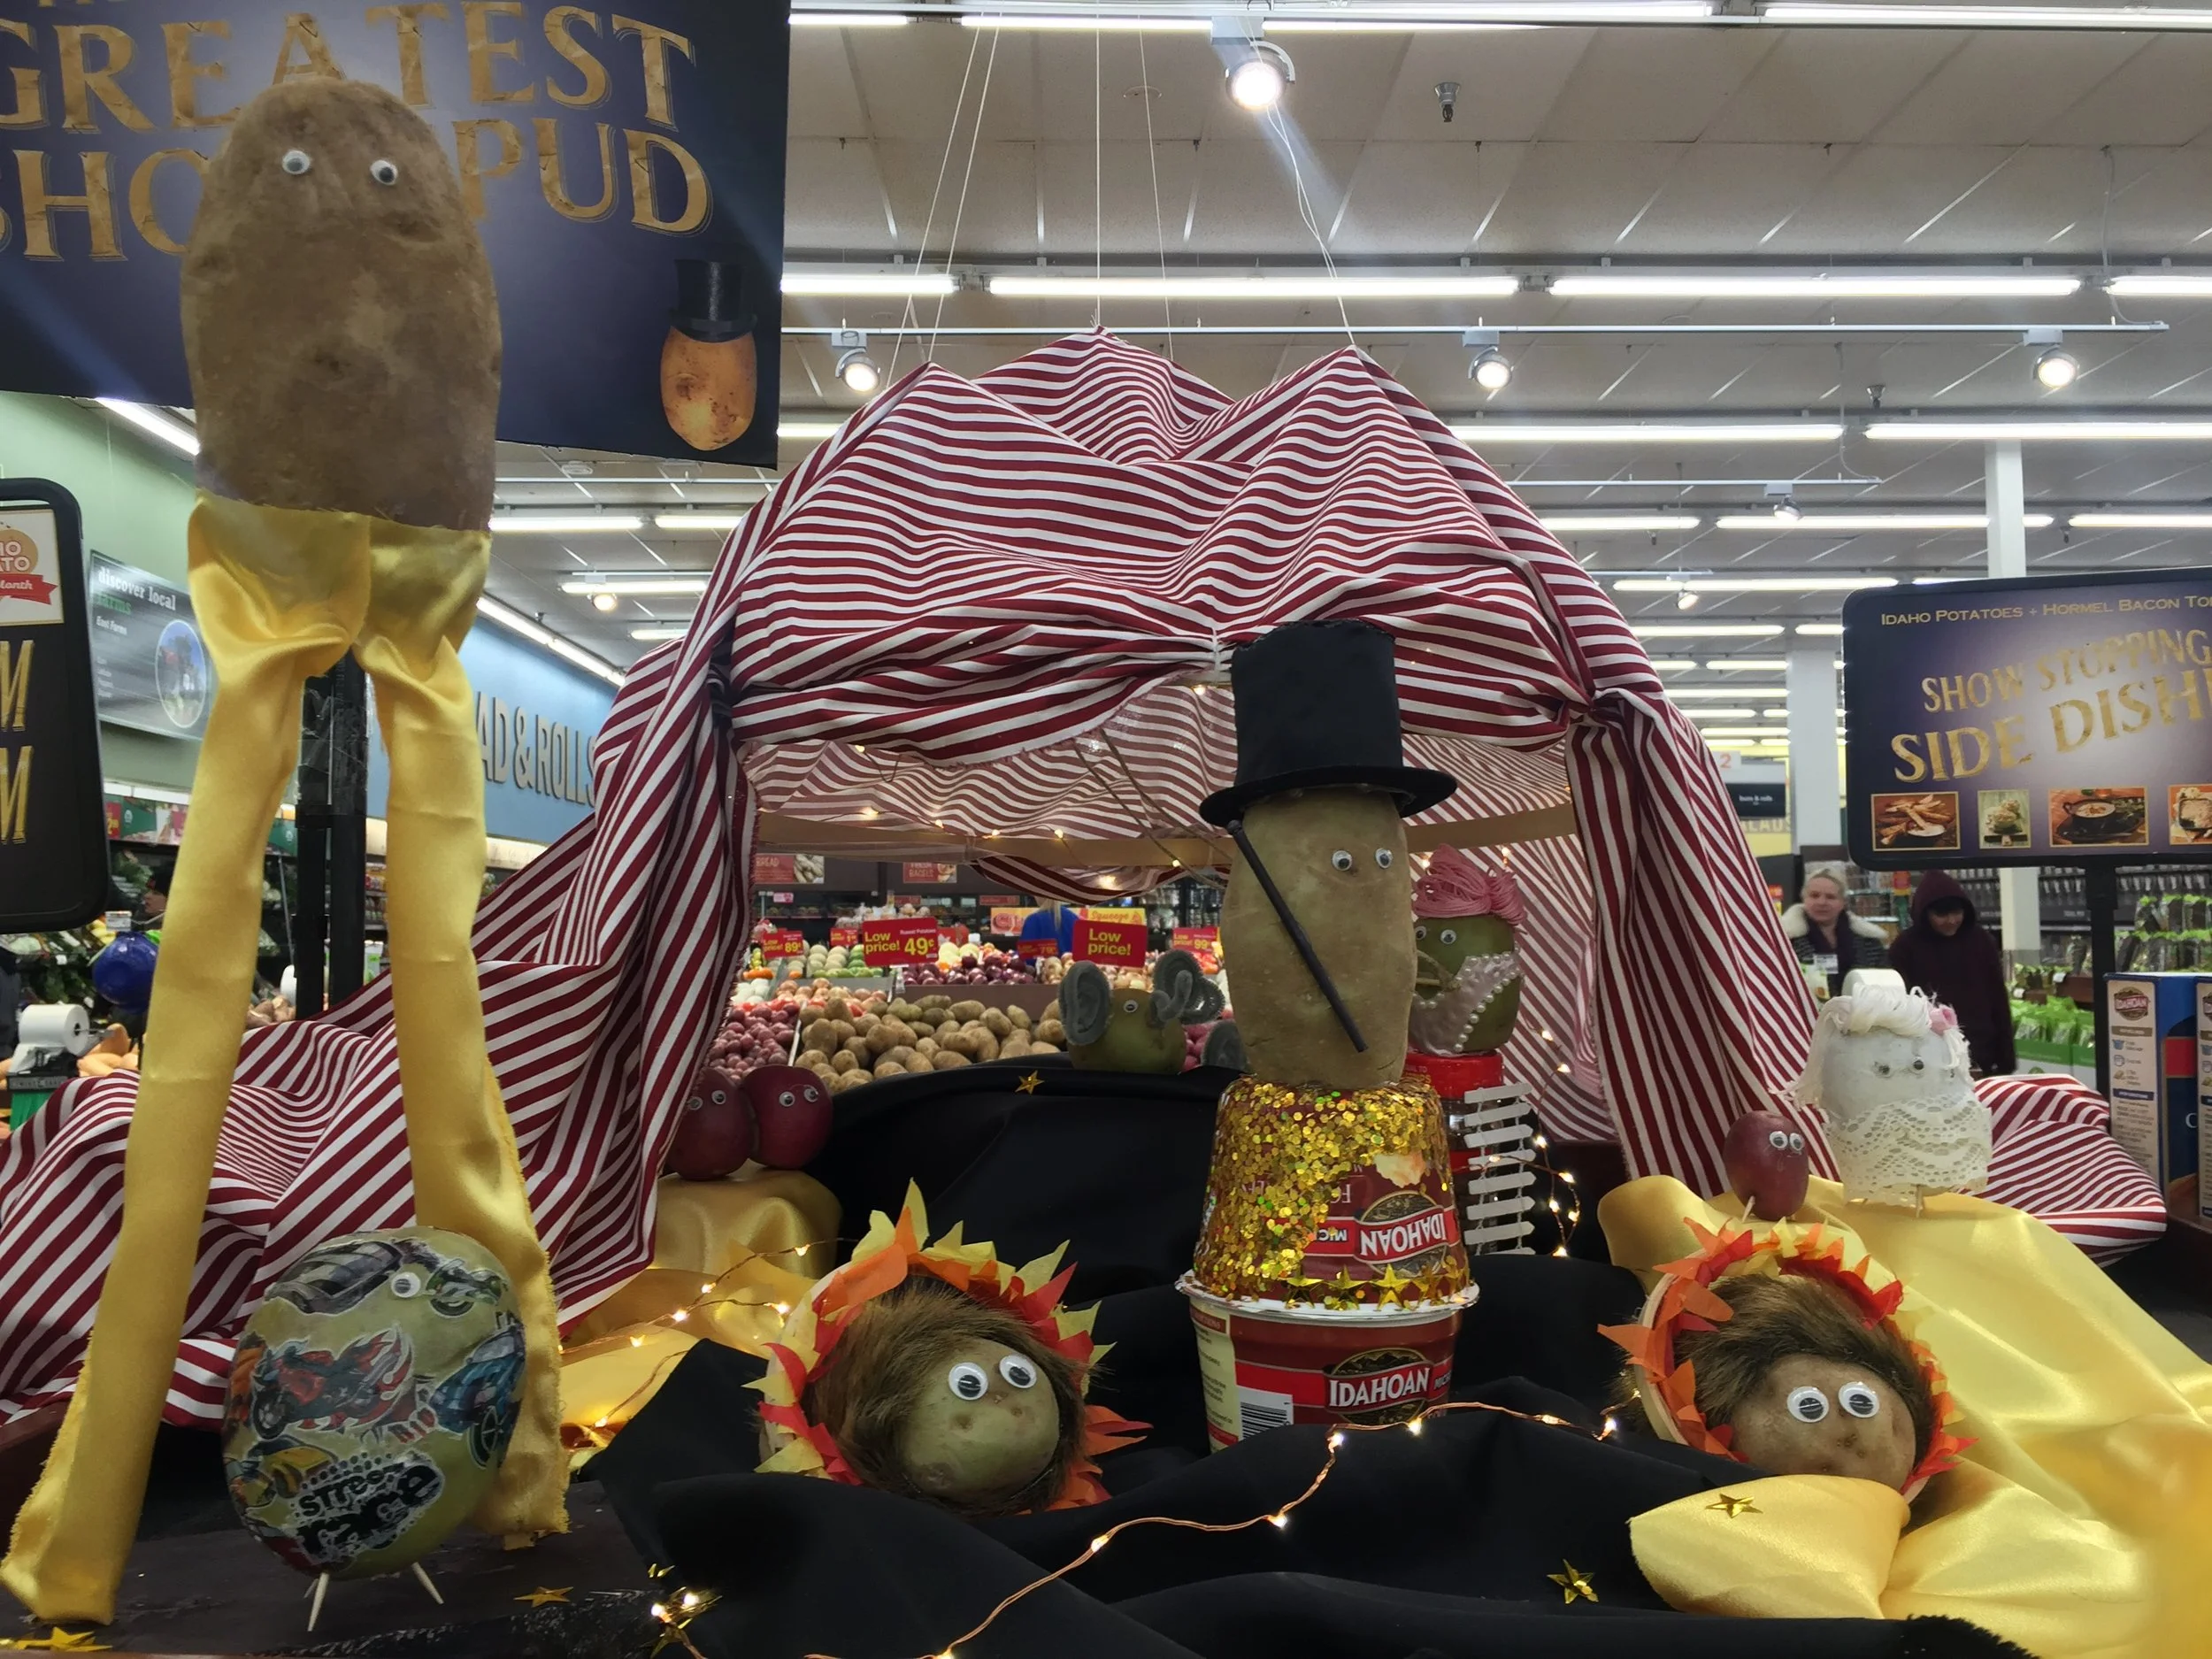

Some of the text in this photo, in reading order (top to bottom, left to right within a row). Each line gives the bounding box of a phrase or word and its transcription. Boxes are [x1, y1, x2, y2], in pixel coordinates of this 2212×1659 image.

[0, 117, 713, 260] HO PUD
[0, 580, 33, 590] onth
[98, 566, 176, 611] discover local
[1881, 612, 1932, 626] IDAHO
[1936, 607, 2024, 622] POTATOES
[2043, 602, 2113, 616] HORMEL
[2119, 597, 2180, 611] BACON
[1922, 628, 2212, 713] SHOW STOPPING
[477, 691, 510, 784] AD
[1891, 715, 2032, 783] SIDE
[864, 932, 891, 942] Low
[865, 940, 900, 954] price!
[1088, 942, 1132, 956] price!
[1089, 928, 1121, 942] Low
[1360, 1213, 1447, 1256] IDAHOAN
[1329, 1367, 1430, 1407] IDAHOAN
